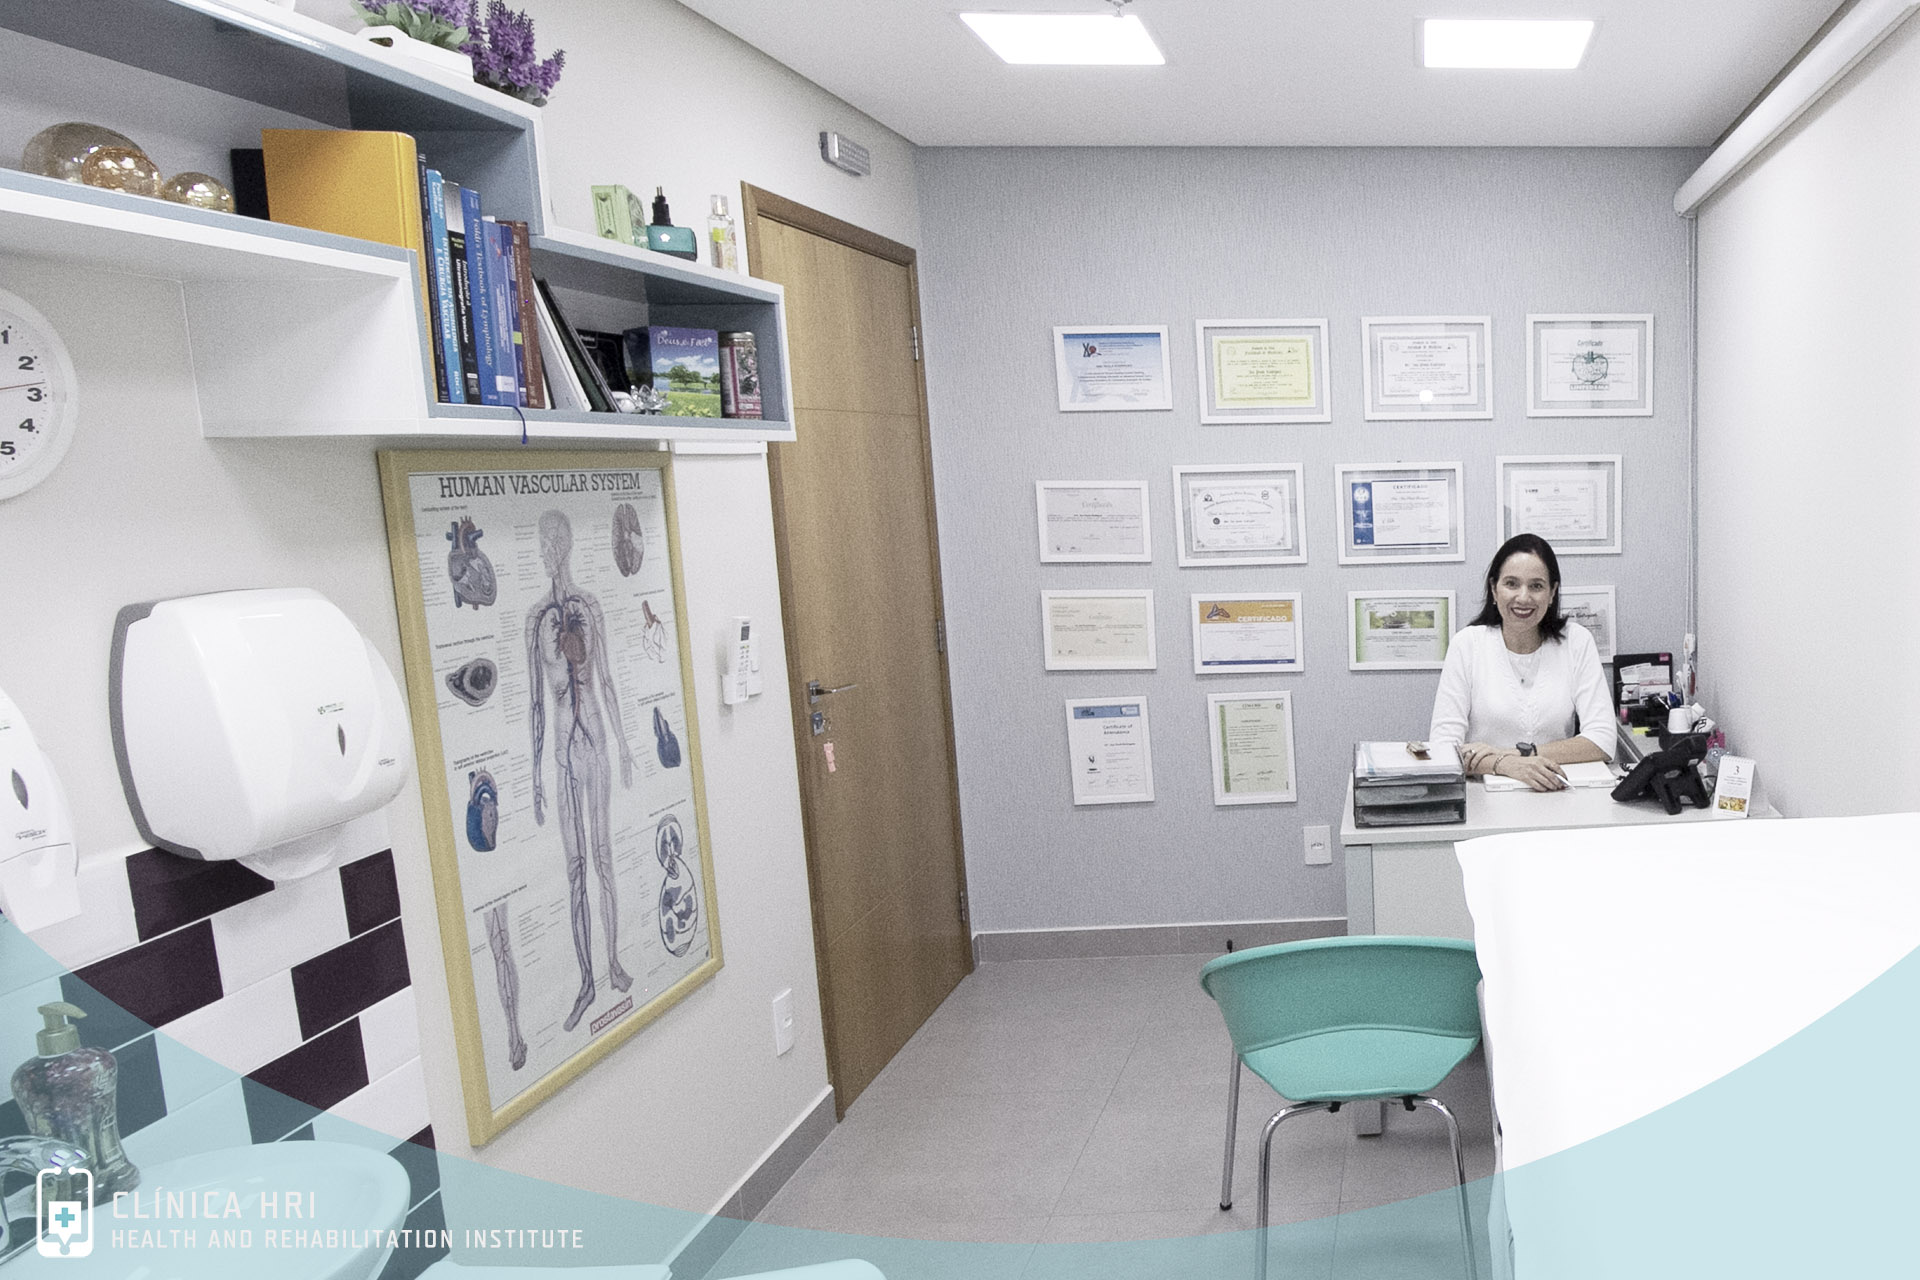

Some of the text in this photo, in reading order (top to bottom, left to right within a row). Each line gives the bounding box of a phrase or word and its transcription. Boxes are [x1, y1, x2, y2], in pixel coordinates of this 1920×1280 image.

[476, 252, 486, 294] Textbook
[481, 297, 488, 306] of
[442, 299, 452, 339] VASCULAR
[0, 329, 9, 344] 1
[461, 316, 469, 344] Vascular
[481, 309, 493, 368] Lymphology
[657, 334, 680, 345] Deus
[18, 356, 34, 370] 2
[27, 387, 43, 402] 3
[19, 418, 35, 432] 4
[0, 441, 16, 455] 5
[438, 472, 641, 498] HUMAN VASCULAR SYSTEM
